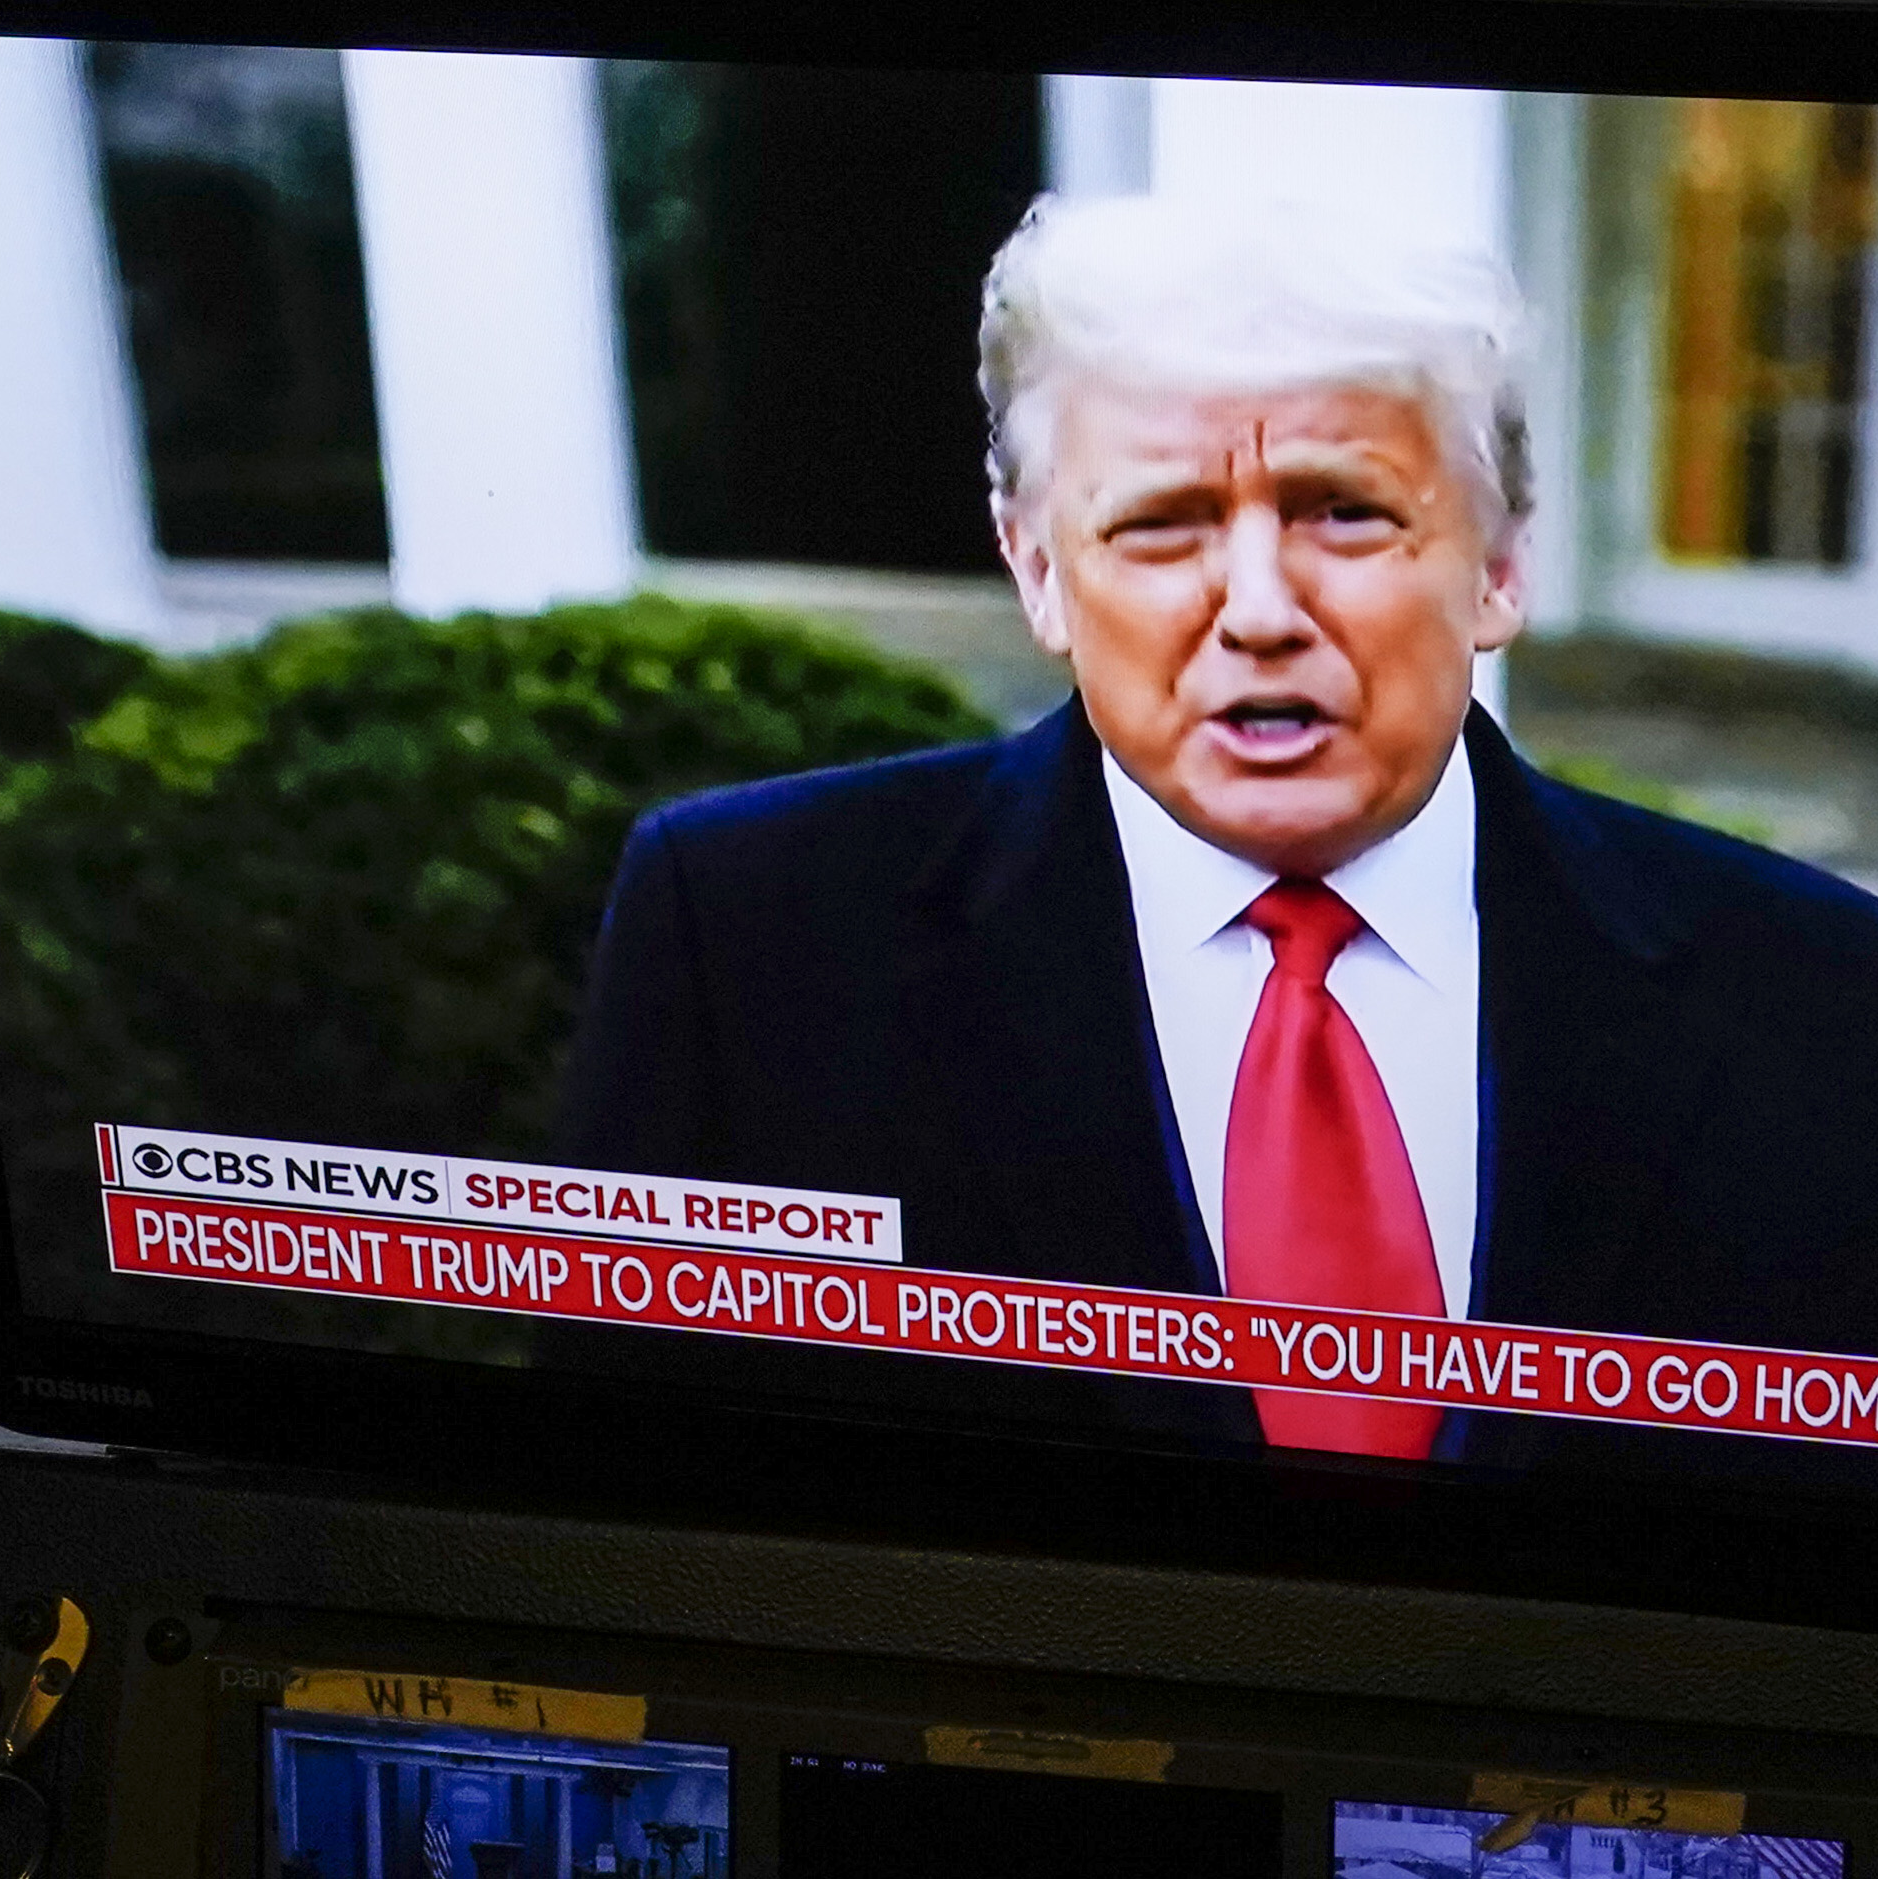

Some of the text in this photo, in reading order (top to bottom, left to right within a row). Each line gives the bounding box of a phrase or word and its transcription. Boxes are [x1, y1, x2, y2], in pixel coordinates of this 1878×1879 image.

[177, 1148, 440, 1205] CBS NEWS
[465, 1173, 884, 1246] SPECIAL REPORT
[135, 1208, 389, 1285] PRESIDENT
[400, 1235, 569, 1302] TRUMP
[580, 1252, 653, 1312] TO
[666, 1261, 885, 1336] CAPITOL
[898, 1283, 1234, 1370] PROTESTERS:
[1251, 1317, 1383, 1384] "YOU
[1401, 1331, 1540, 1399] HAVE
[1554, 1345, 1631, 1407] TO
[1647, 1355, 1738, 1417] GO
[14, 1374, 155, 1409] TOSHIBA
